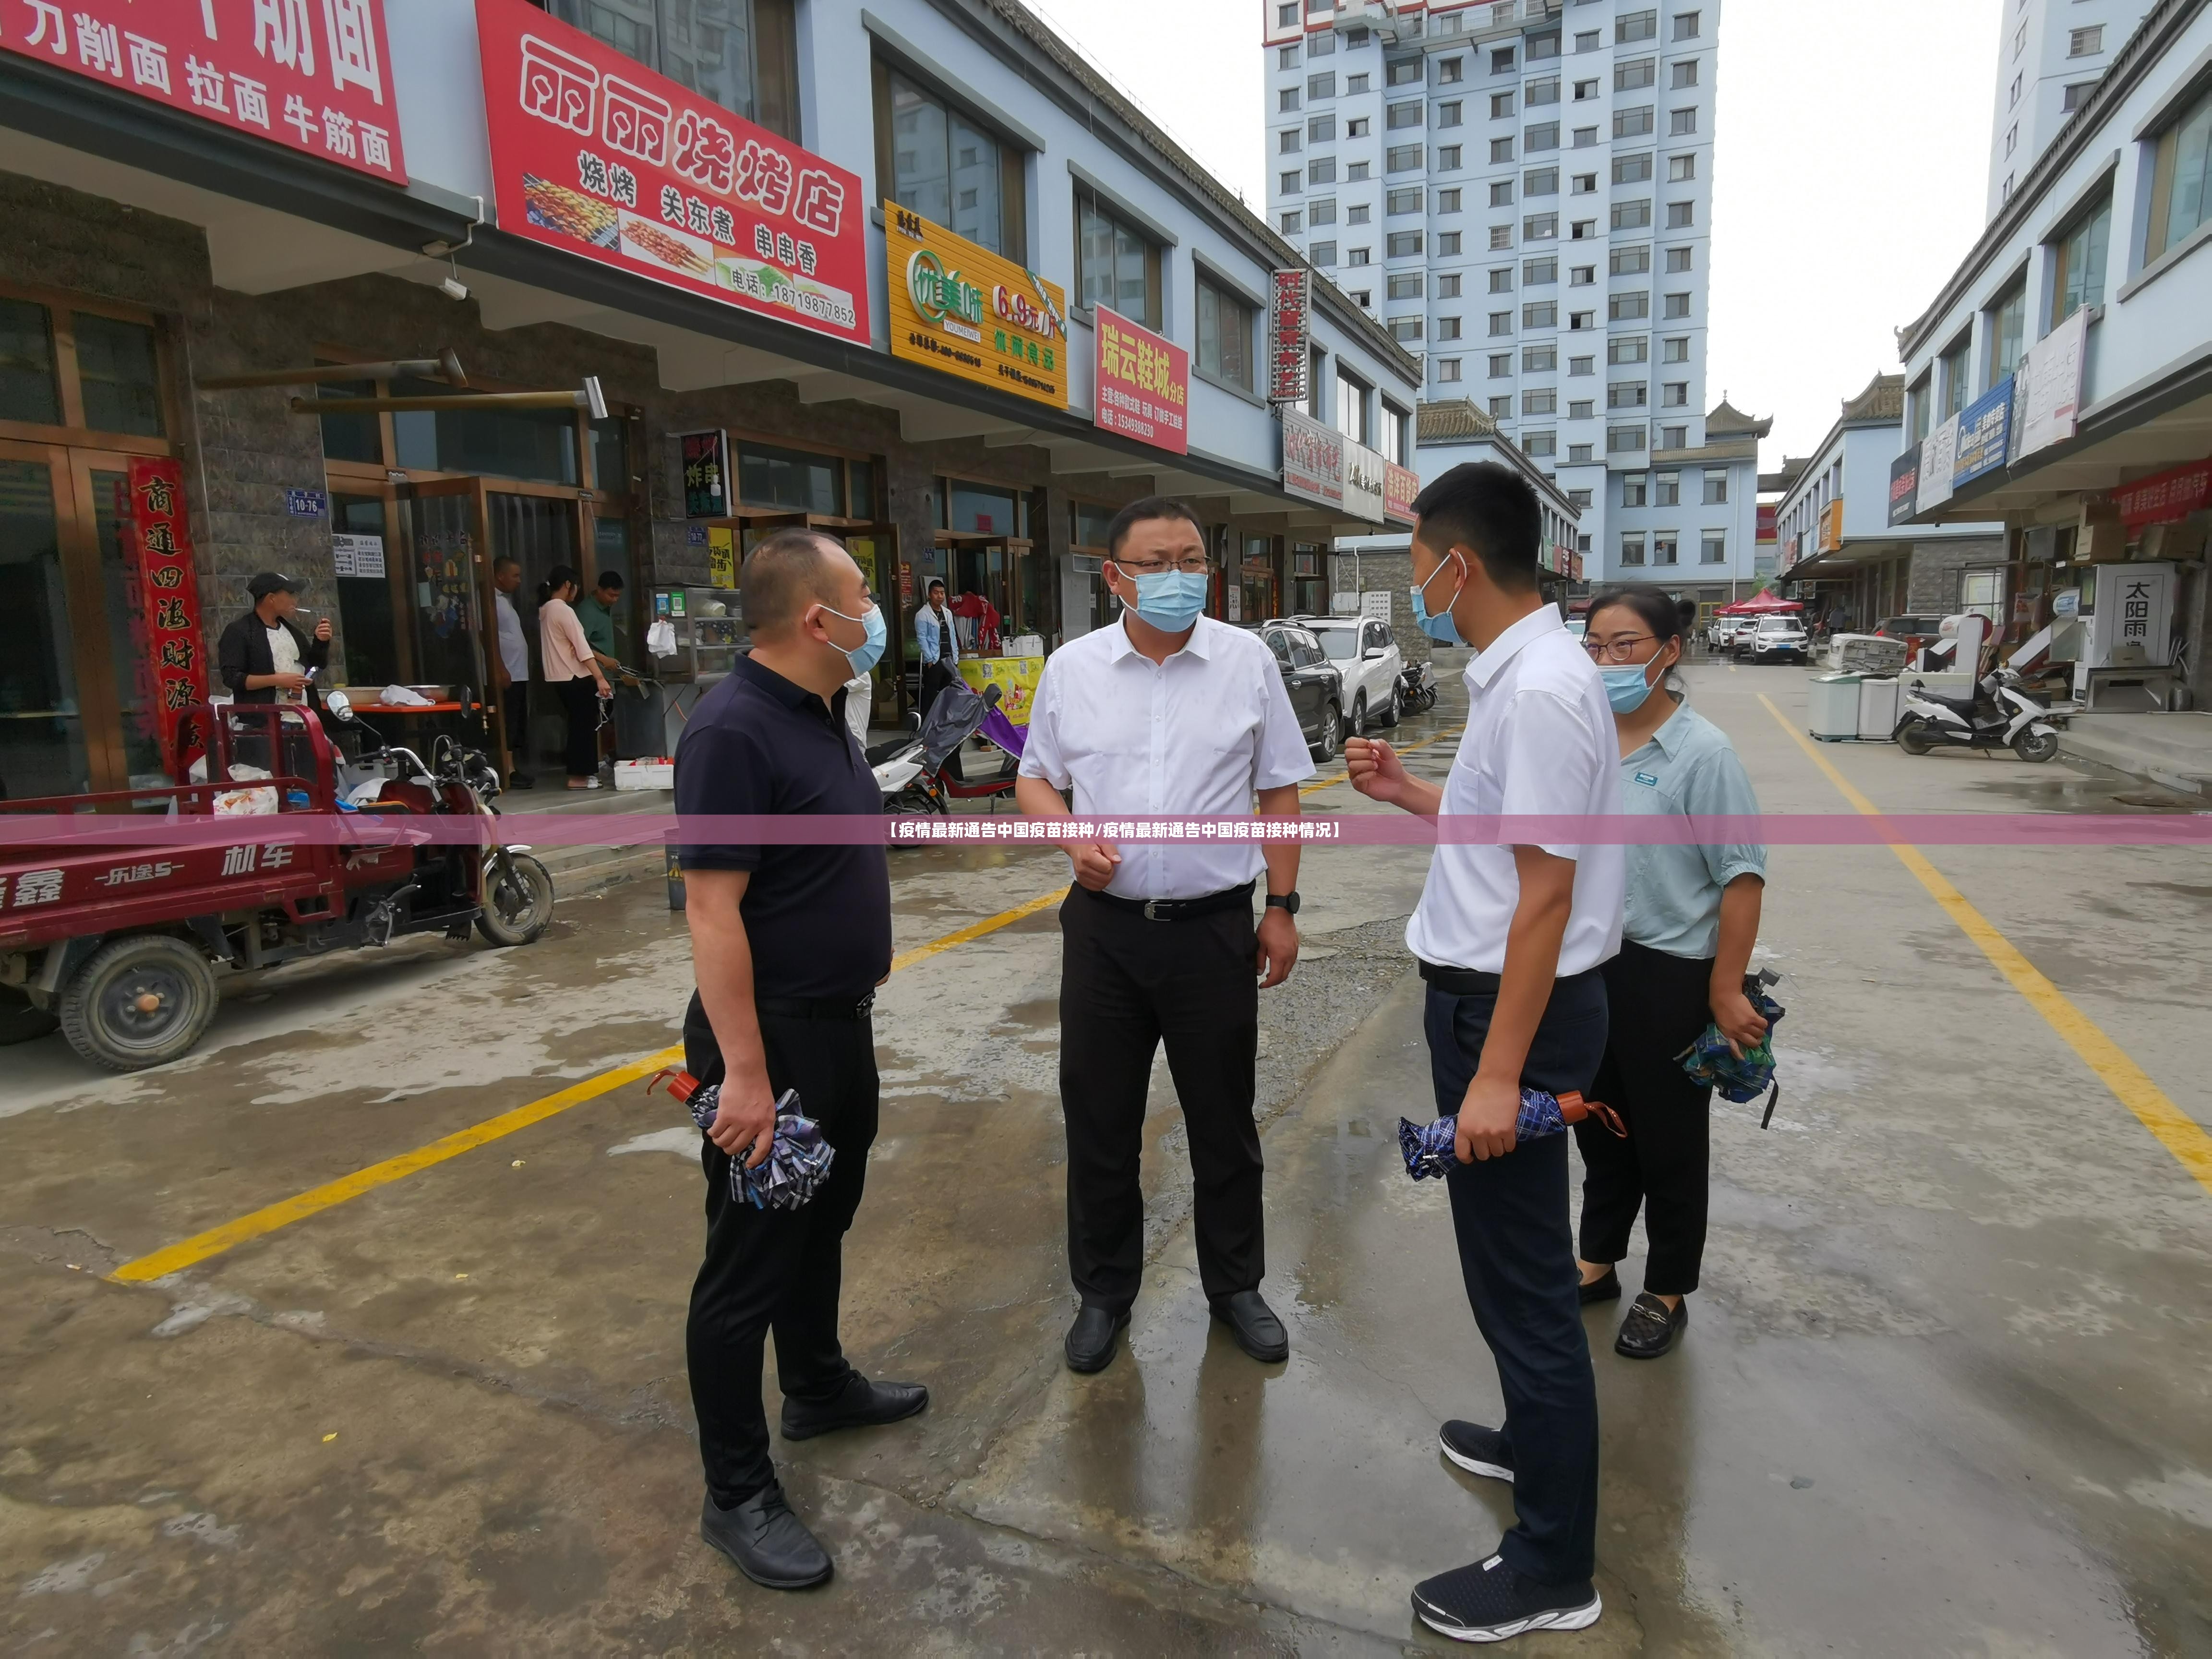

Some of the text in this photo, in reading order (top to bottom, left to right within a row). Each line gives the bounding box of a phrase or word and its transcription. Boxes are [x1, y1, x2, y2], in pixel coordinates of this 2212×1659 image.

[23, 0, 392, 172] 刀削面 拉面 牛筋面
[520, 34, 844, 238] 丽丽烧烤店
[578, 150, 817, 276] 烧烤 关东煮 串串香
[915, 262, 984, 325] 优美味
[944, 321, 980, 341] YOUMEIWEI
[994, 328, 1055, 371] 休闲食品
[295, 499, 318, 513] 10-76
[221, 841, 295, 877] 机车
[0, 869, 64, 908] 鑫
